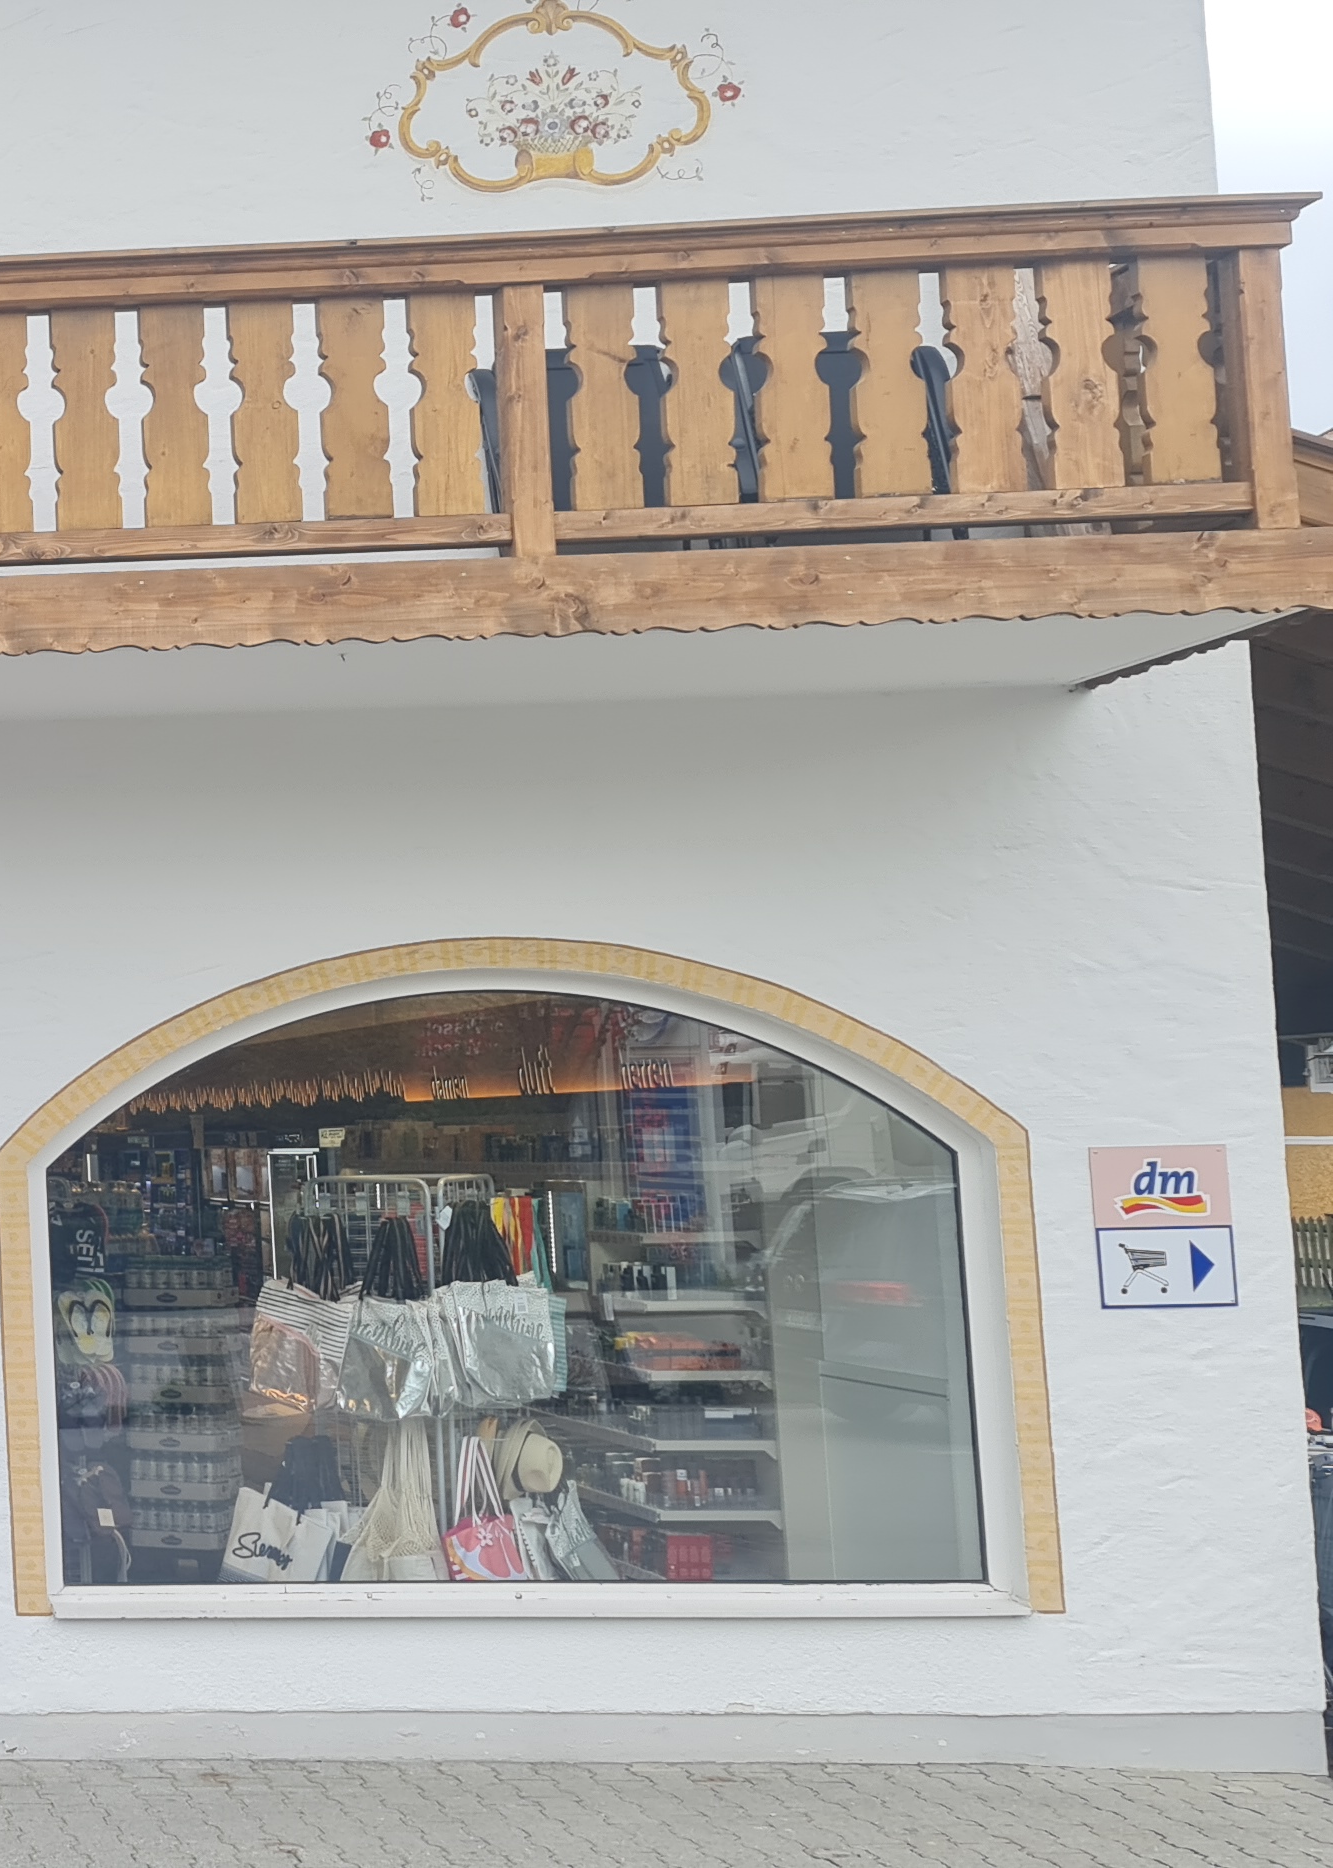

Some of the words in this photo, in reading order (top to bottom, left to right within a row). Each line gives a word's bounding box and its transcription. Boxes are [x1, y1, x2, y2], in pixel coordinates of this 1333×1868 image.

[431, 1065, 470, 1100] damen
[519, 1044, 557, 1096] duft
[617, 1048, 675, 1091] herren
[1133, 1160, 1196, 1196] dm
